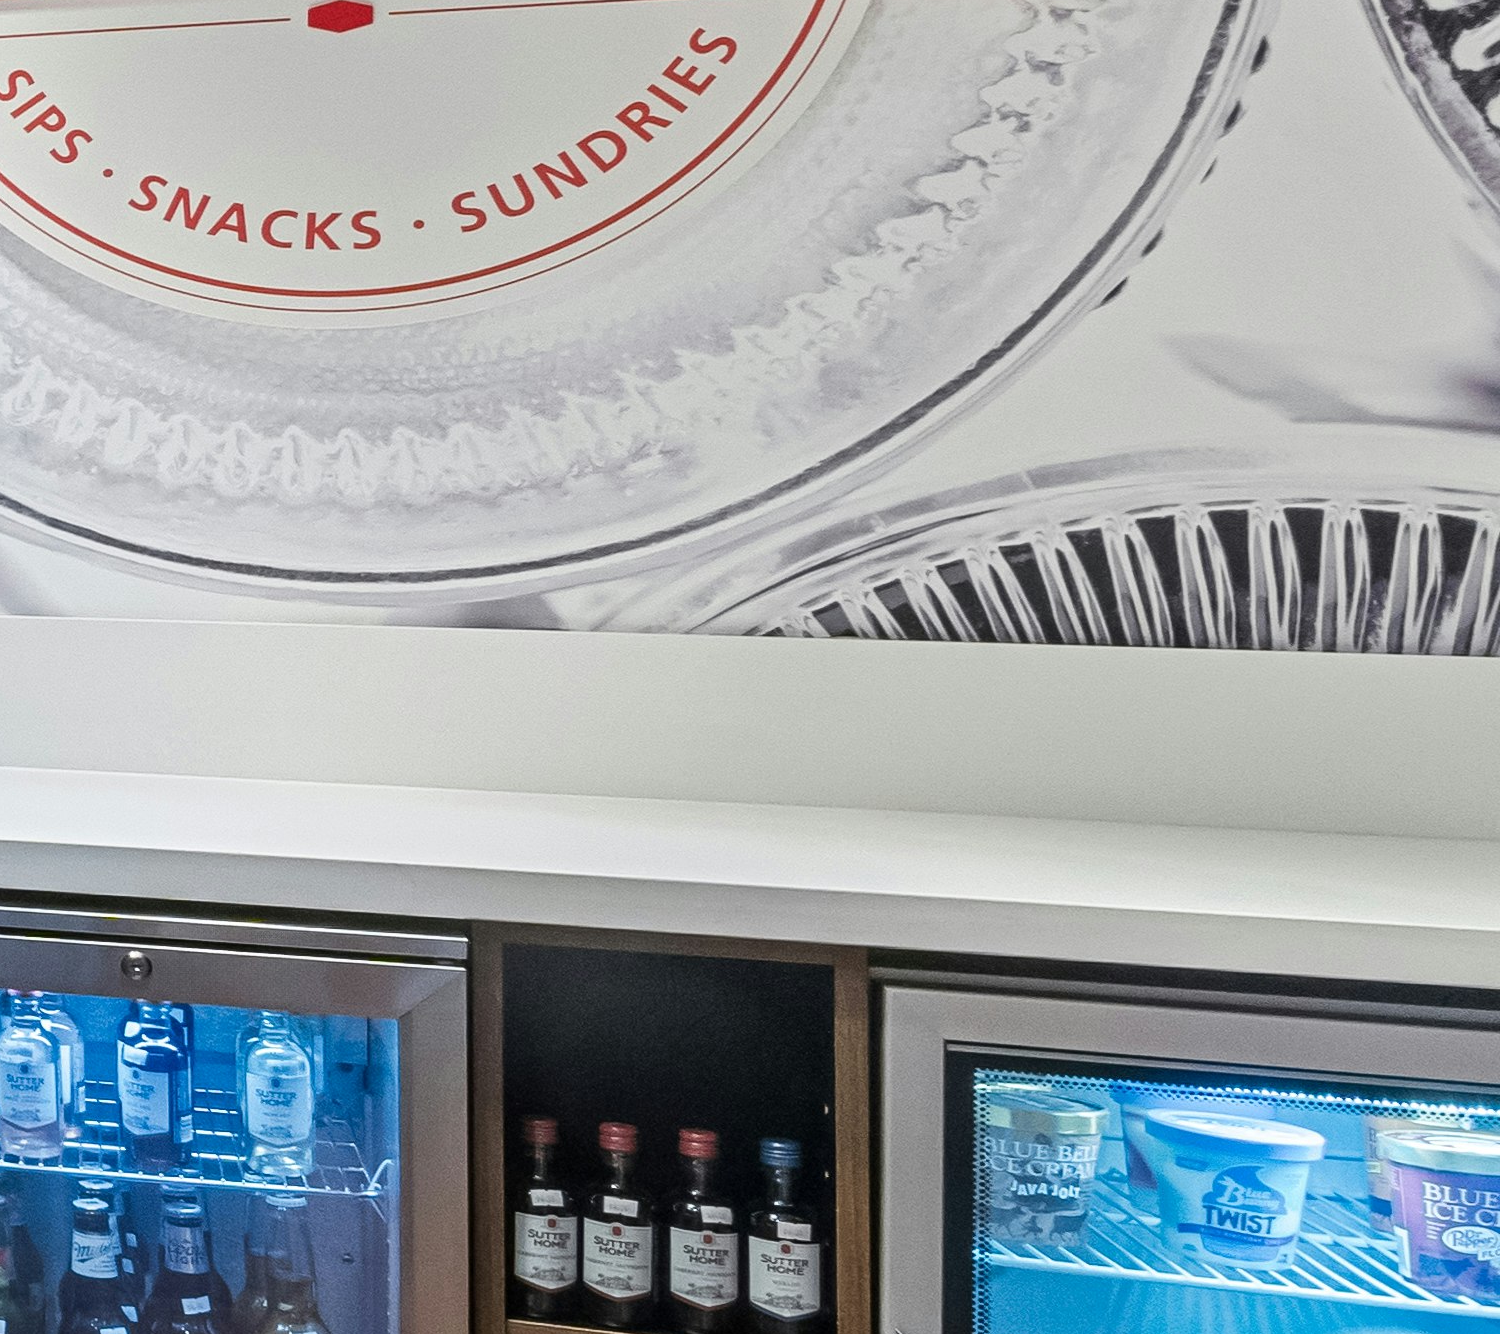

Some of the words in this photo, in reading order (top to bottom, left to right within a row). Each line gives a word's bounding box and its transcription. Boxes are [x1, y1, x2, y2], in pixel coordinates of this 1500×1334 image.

[128, 173, 383, 252] SNACKS
[450, 24, 741, 235] SUNDRIES
[1010, 1180, 1048, 1197] JAVA
[1051, 1183, 1081, 1199] JOLT
[1422, 1181, 1500, 1209] BLUE
[1204, 1205, 1277, 1235] TWIST
[1423, 1201, 1468, 1223] ICE
[528, 1228, 569, 1246] SUTTER
[533, 1239, 568, 1250] HOME
[594, 1234, 641, 1250] SUTTER
[599, 1244, 635, 1258] HOME
[683, 1244, 729, 1258] SUTTER
[689, 1253, 725, 1266] HOME
[760, 1253, 809, 1269] SUTTER
[766, 1264, 805, 1276] HOME
